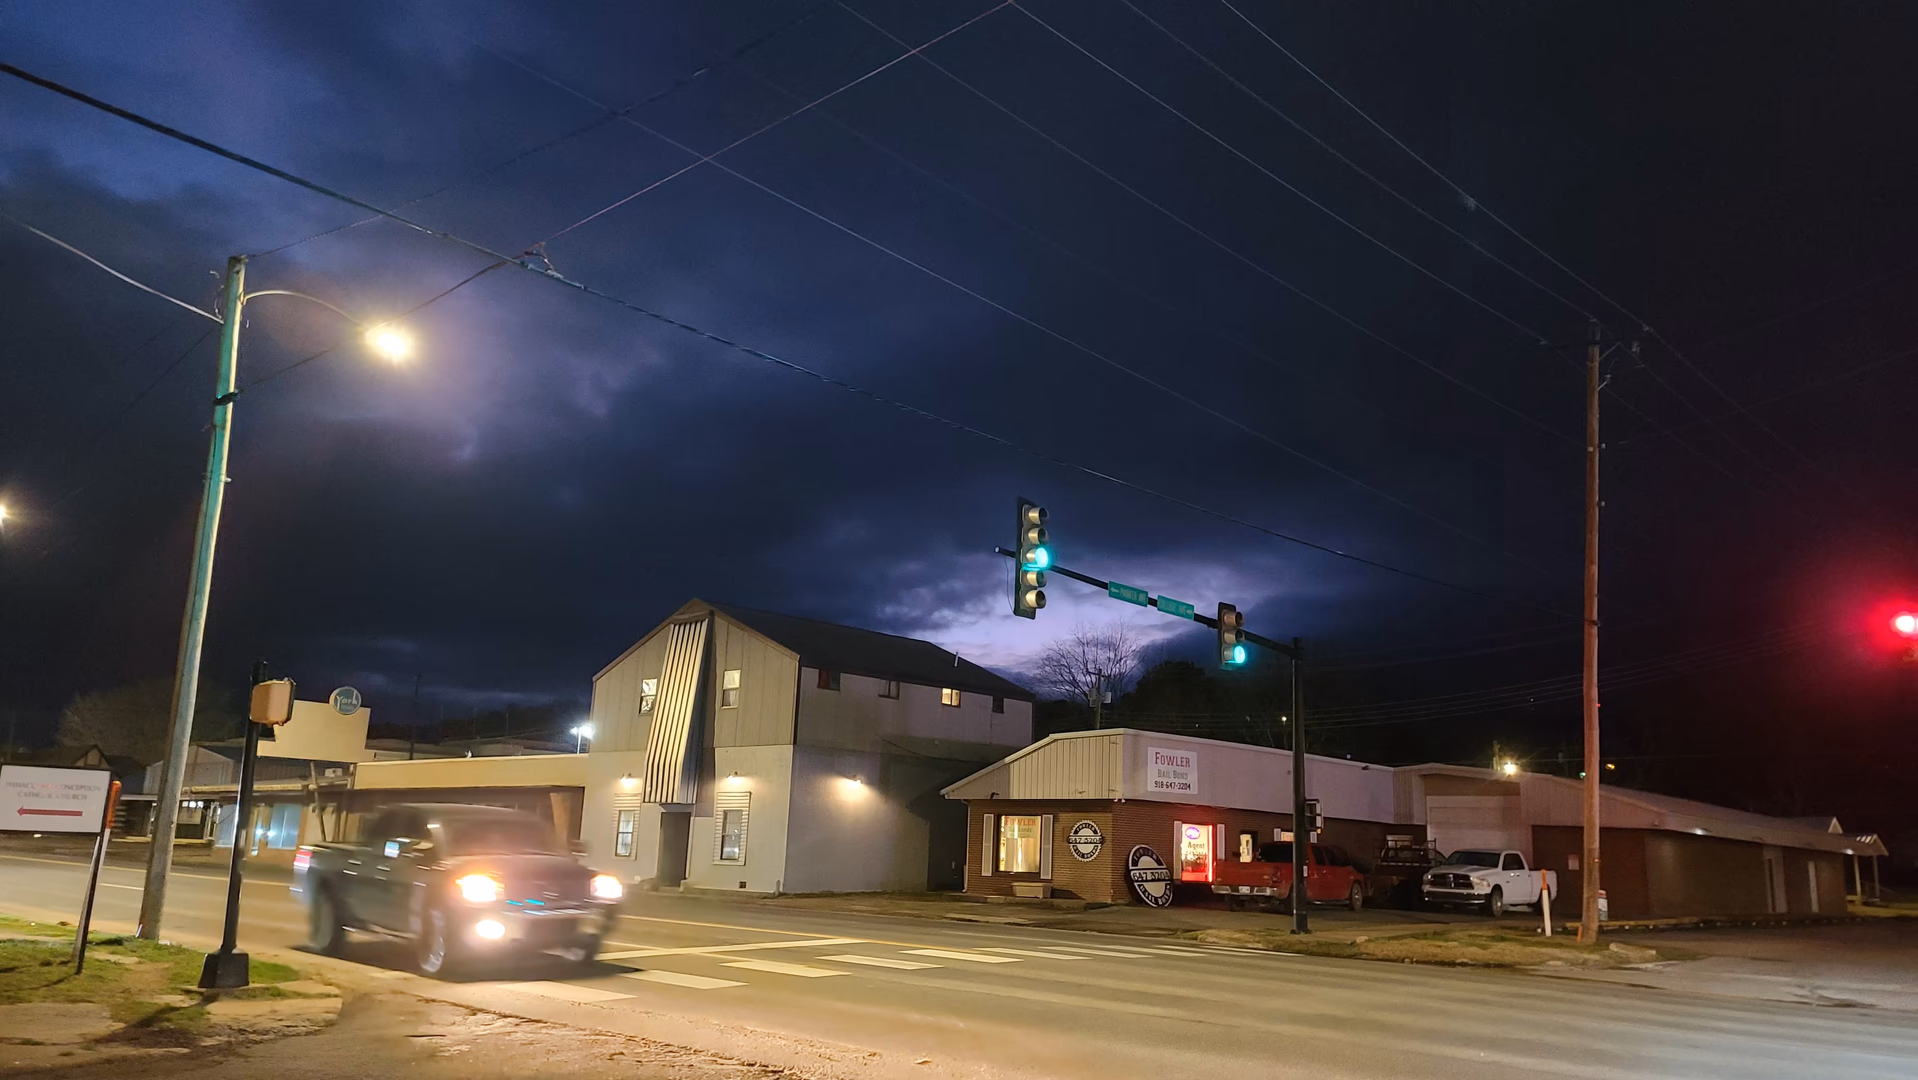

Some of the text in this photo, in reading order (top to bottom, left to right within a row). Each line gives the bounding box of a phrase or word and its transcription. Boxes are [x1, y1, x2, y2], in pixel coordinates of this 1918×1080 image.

[1154, 751, 1191, 768] FOWLER
[1157, 768, 1172, 779] BAIL
[1154, 780, 1191, 791] 918-647-3204
[1005, 815, 1036, 826] FOWLER
[1187, 841, 1205, 851] Agent
